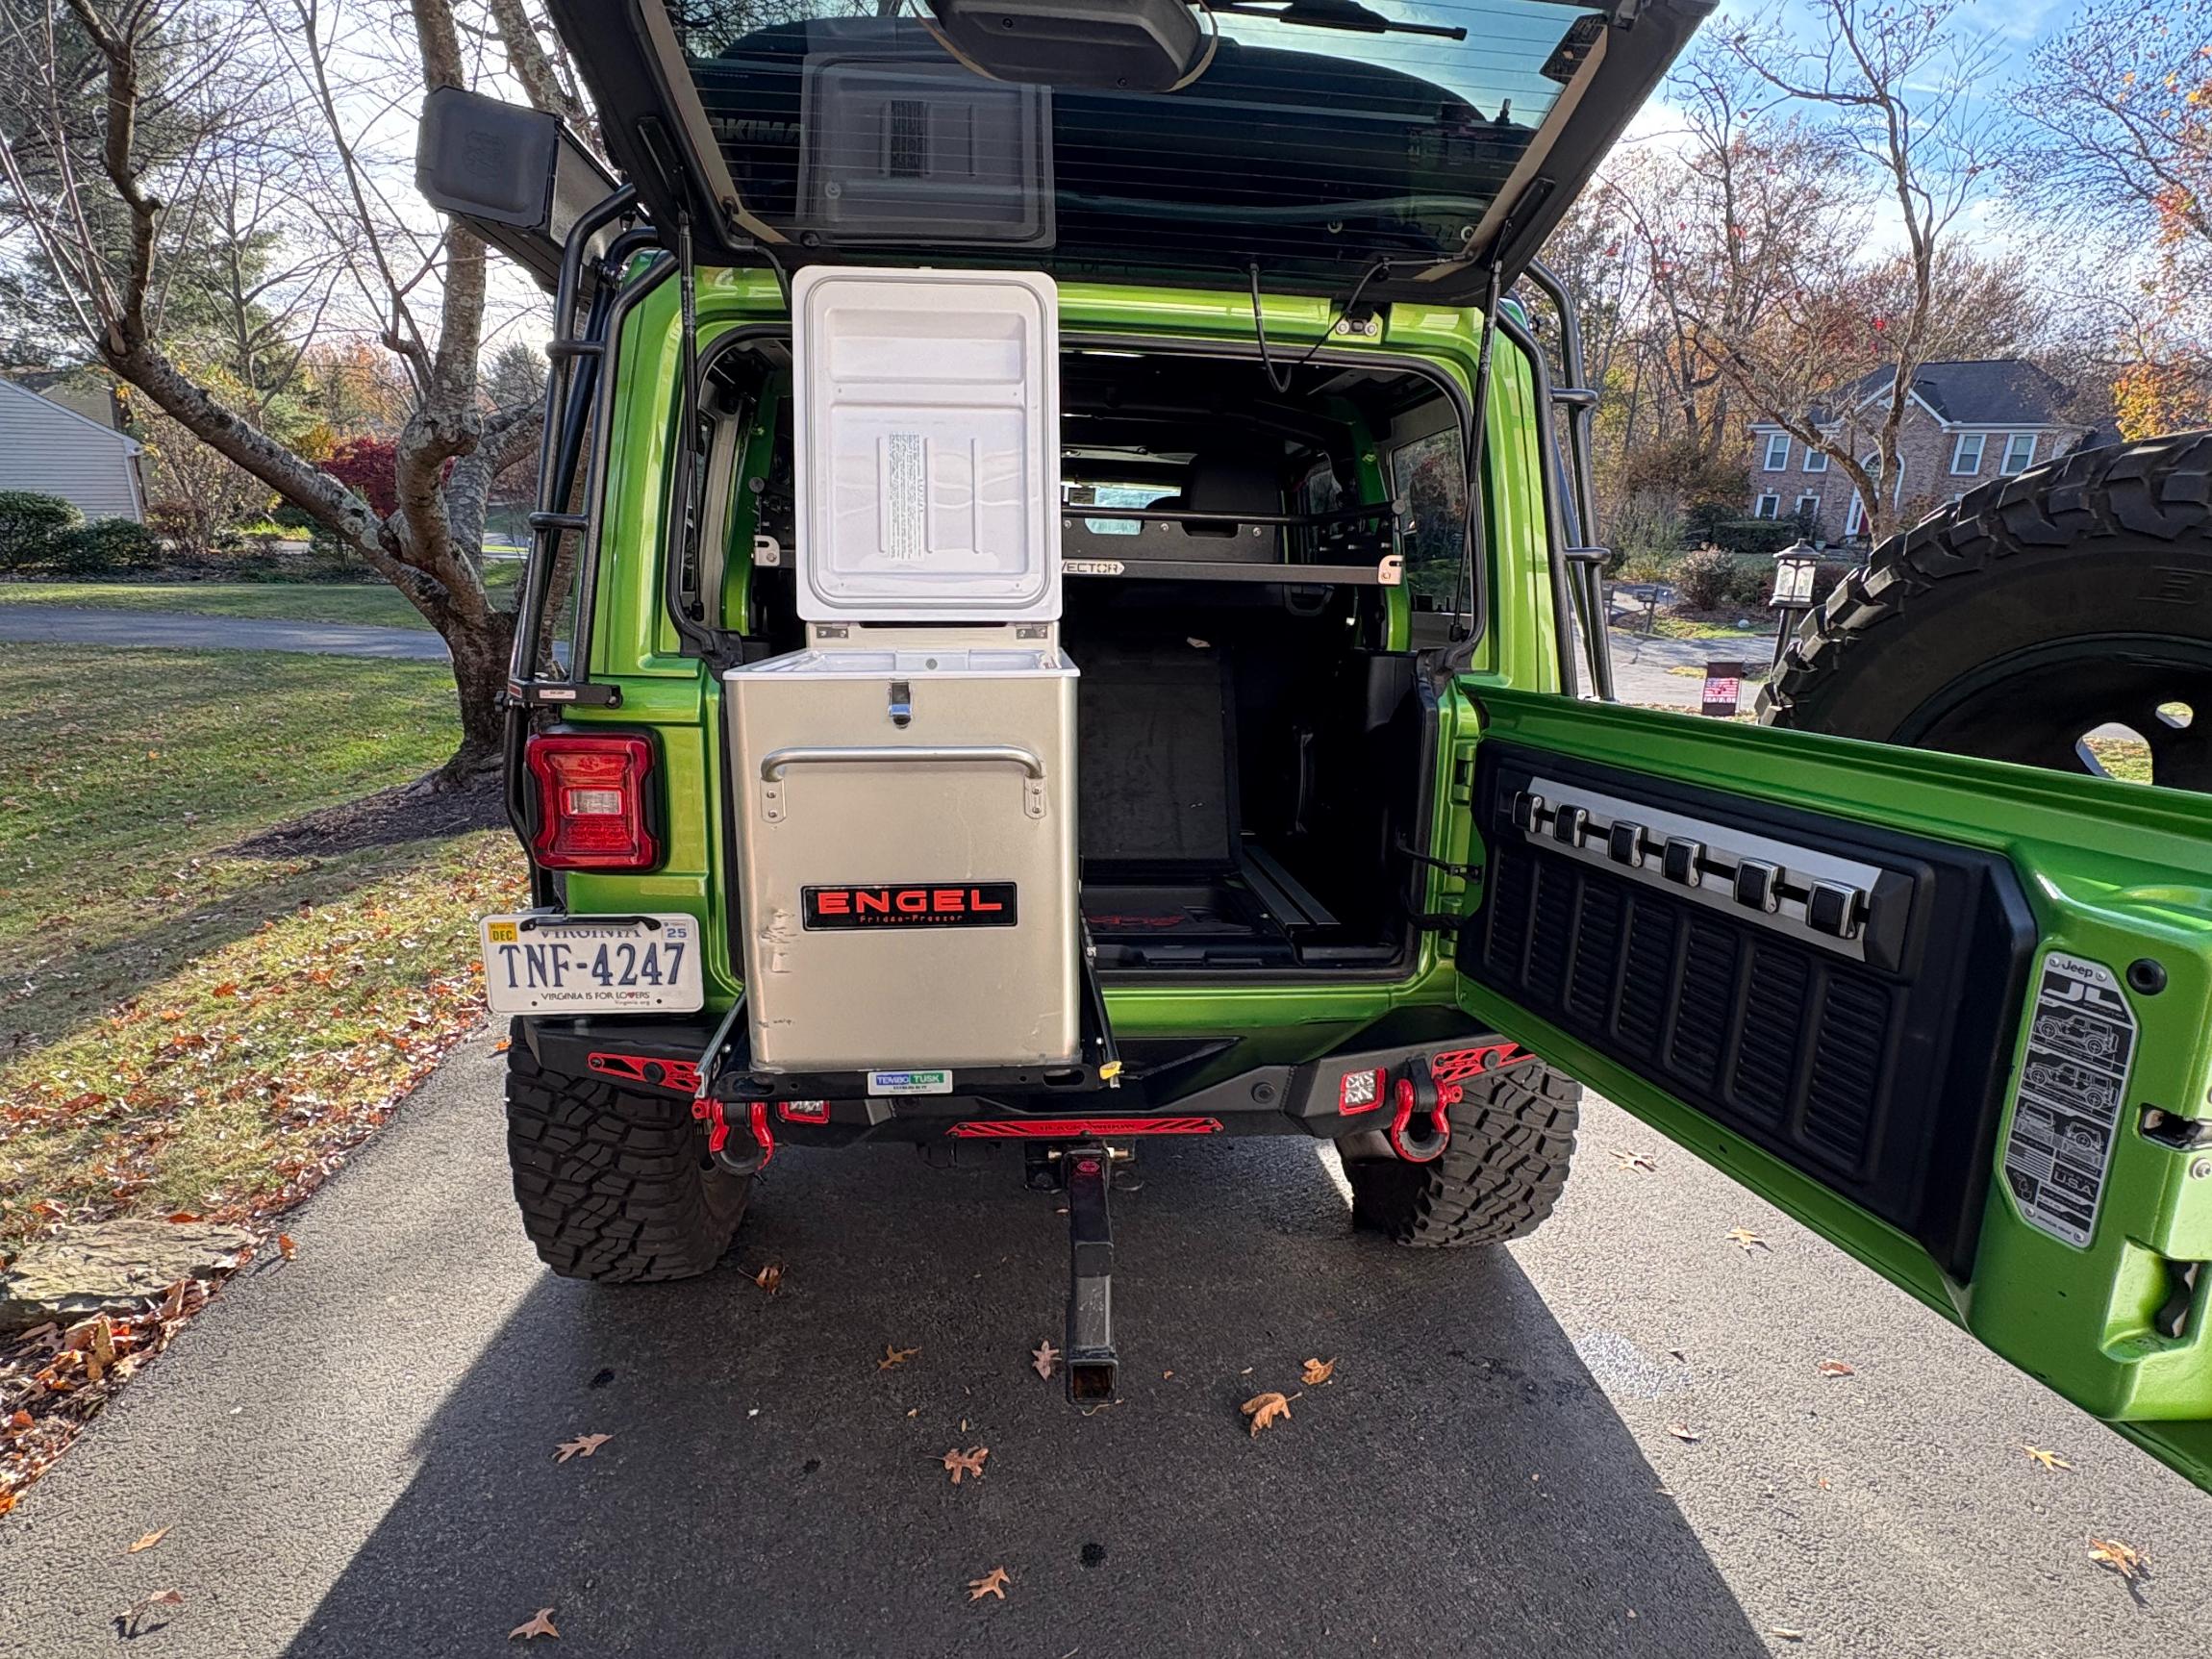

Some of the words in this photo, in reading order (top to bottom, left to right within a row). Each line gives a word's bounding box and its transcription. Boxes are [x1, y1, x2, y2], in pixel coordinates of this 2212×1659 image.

[817, 890, 1002, 914] ENGEL
[492, 930, 513, 941] DEC
[666, 927, 688, 939] 25
[498, 942, 686, 989] TNF-4247
[2061, 960, 2094, 978] Jeep
[540, 992, 584, 1001] VIRGINIA
[586, 992, 592, 1000] IS
[595, 992, 614, 1000] FOR
[2044, 981, 2123, 1012] JL
[877, 1075, 909, 1085] TEMBO
[914, 1074, 940, 1084] TUSK
